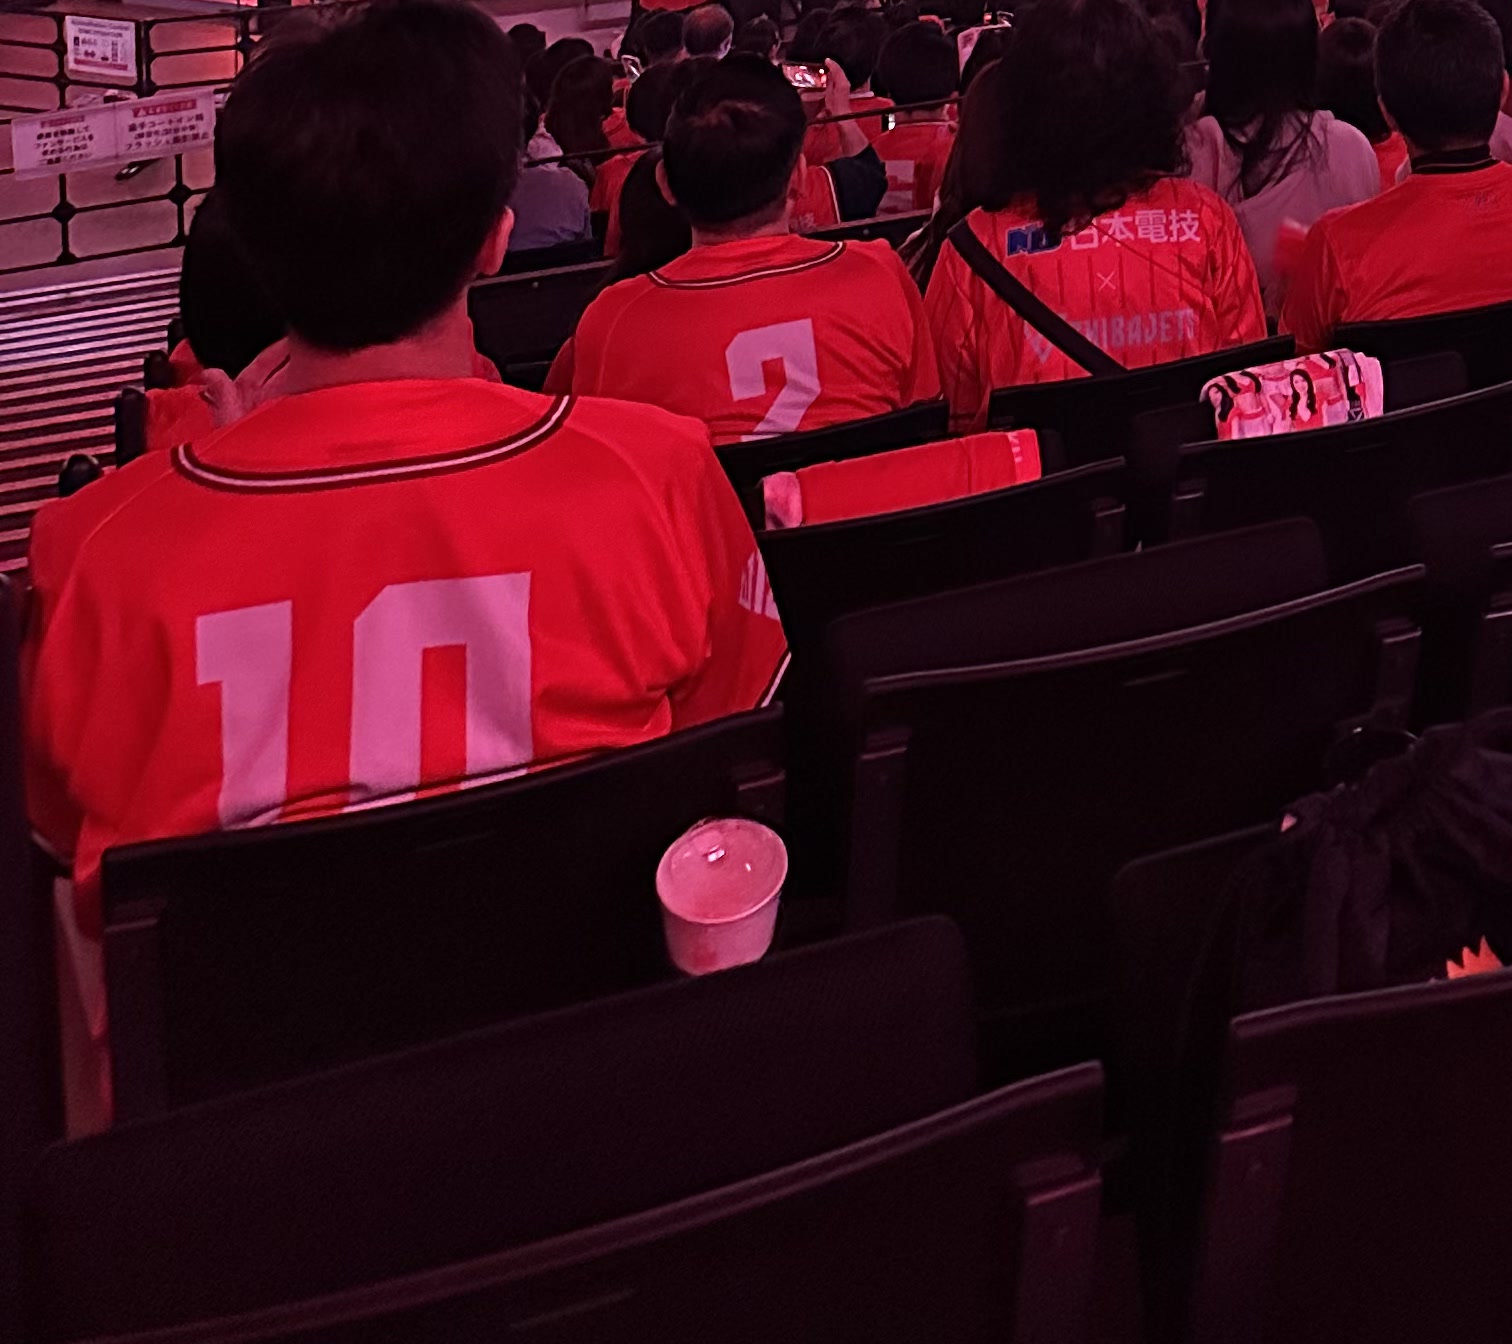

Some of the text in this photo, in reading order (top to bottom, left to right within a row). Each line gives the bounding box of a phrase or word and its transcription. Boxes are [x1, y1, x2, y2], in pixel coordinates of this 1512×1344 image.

[1070, 209, 1200, 250] 日本電技
[195, 571, 534, 831] 10
